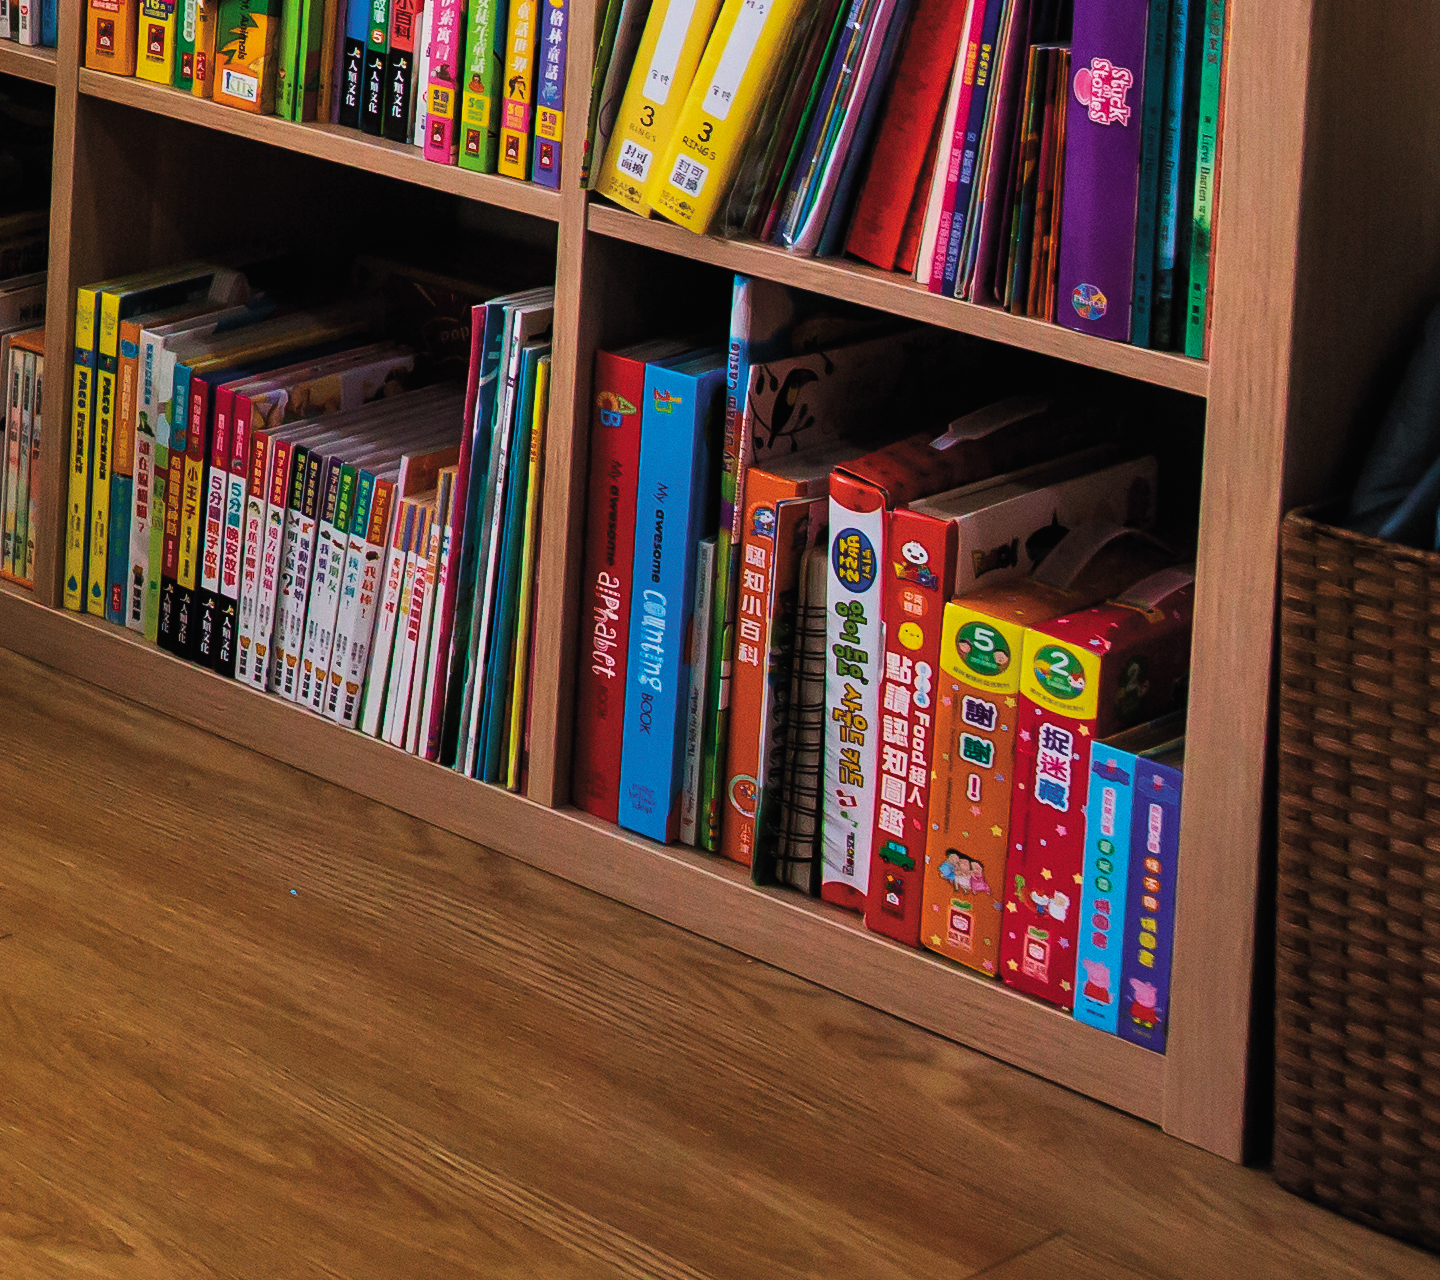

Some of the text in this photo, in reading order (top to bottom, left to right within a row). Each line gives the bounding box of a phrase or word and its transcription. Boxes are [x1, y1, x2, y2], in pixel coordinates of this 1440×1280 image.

[345, 59, 358, 107] 人類文化
[367, 70, 379, 114] 人類文化
[391, 70, 404, 118] 人類文化
[1090, 57, 1134, 127] Stuck on Stories
[639, 105, 655, 127] 3
[698, 121, 714, 143] 3
[682, 135, 717, 161] RINGS
[727, 341, 741, 391] Castle
[725, 396, 737, 446] Dream
[185, 467, 199, 520] 小王子
[653, 482, 669, 504] My
[606, 485, 620, 567] awesome
[651, 509, 665, 583] awesome
[738, 542, 766, 667] 認知小百科
[973, 627, 995, 652] 5
[1050, 651, 1070, 676] 2
[640, 692, 654, 735] BOOK
[878, 651, 912, 838] 點讀認知圖鑑
[1035, 723, 1074, 812] 捉迷藏
